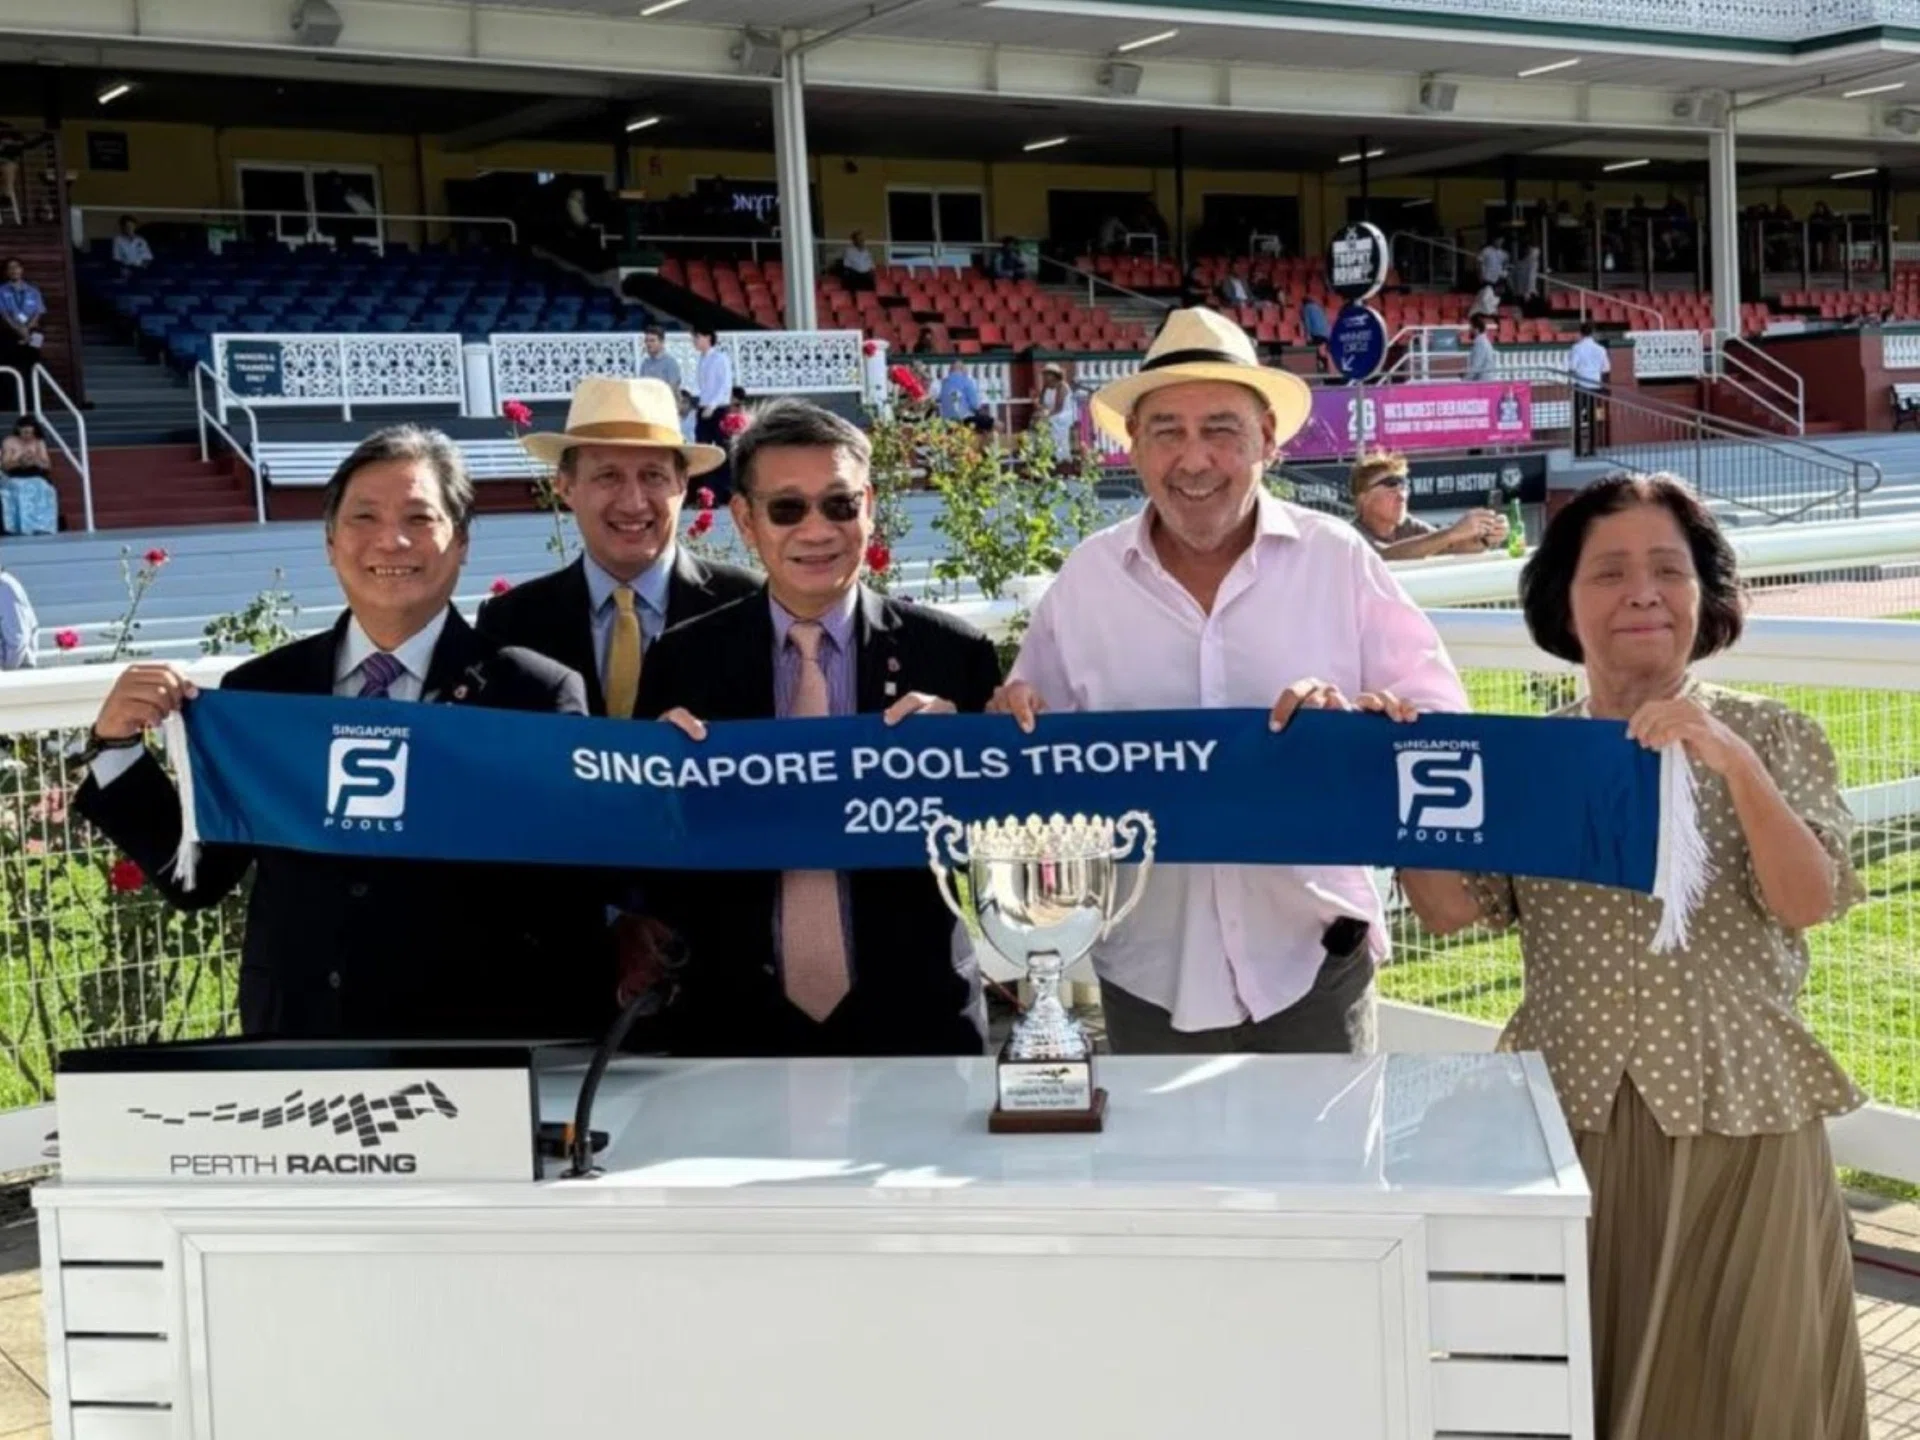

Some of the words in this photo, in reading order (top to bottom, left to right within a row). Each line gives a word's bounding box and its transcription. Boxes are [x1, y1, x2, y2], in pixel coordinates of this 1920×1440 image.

[1412, 476, 1434, 495] WAY
[1456, 472, 1497, 491] HISTORY
[332, 724, 410, 739] SINGAPORE
[1392, 740, 1481, 751] SINGAPORE
[572, 747, 838, 787] SINGAPORE
[851, 746, 1010, 779] POOLS
[1021, 740, 1218, 775] TROPHY
[844, 797, 943, 833] 2025
[324, 817, 404, 832] POOLS
[1397, 828, 1484, 843] POOLS
[170, 1155, 277, 1175] PERTH
[286, 1153, 416, 1174] RACING
